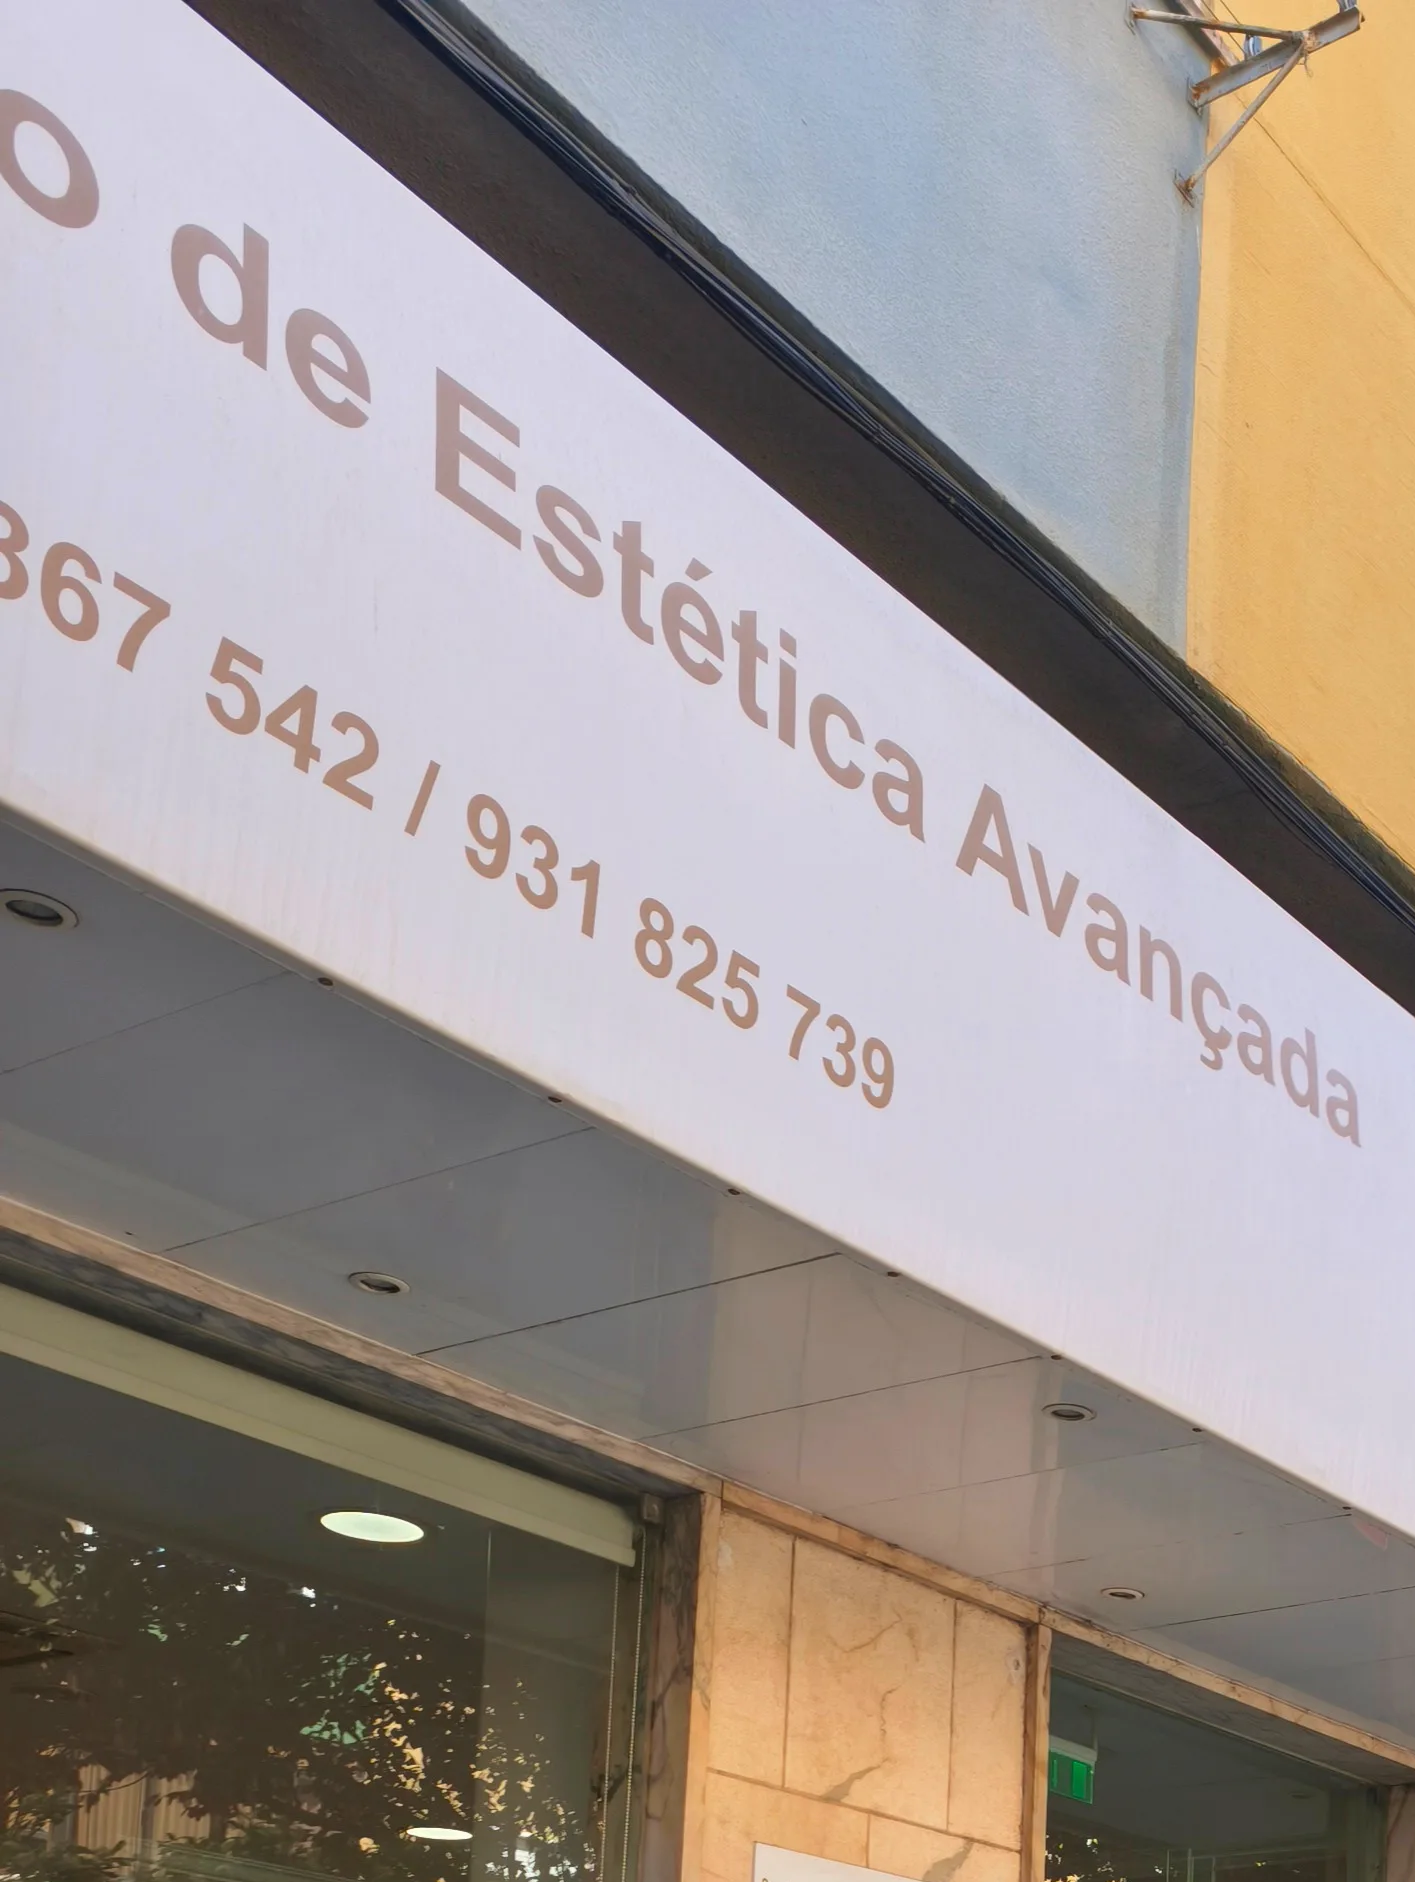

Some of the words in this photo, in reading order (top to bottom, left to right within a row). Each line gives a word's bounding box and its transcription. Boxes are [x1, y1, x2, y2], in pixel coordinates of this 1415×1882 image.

[171, 223, 371, 428] de
[435, 367, 925, 843] Estética
[955, 784, 1361, 1148] Avançada
[205, 636, 379, 811] 542
[404, 760, 441, 836] /
[465, 794, 600, 939] 931
[634, 898, 760, 1030] 825
[786, 984, 894, 1109] 739
